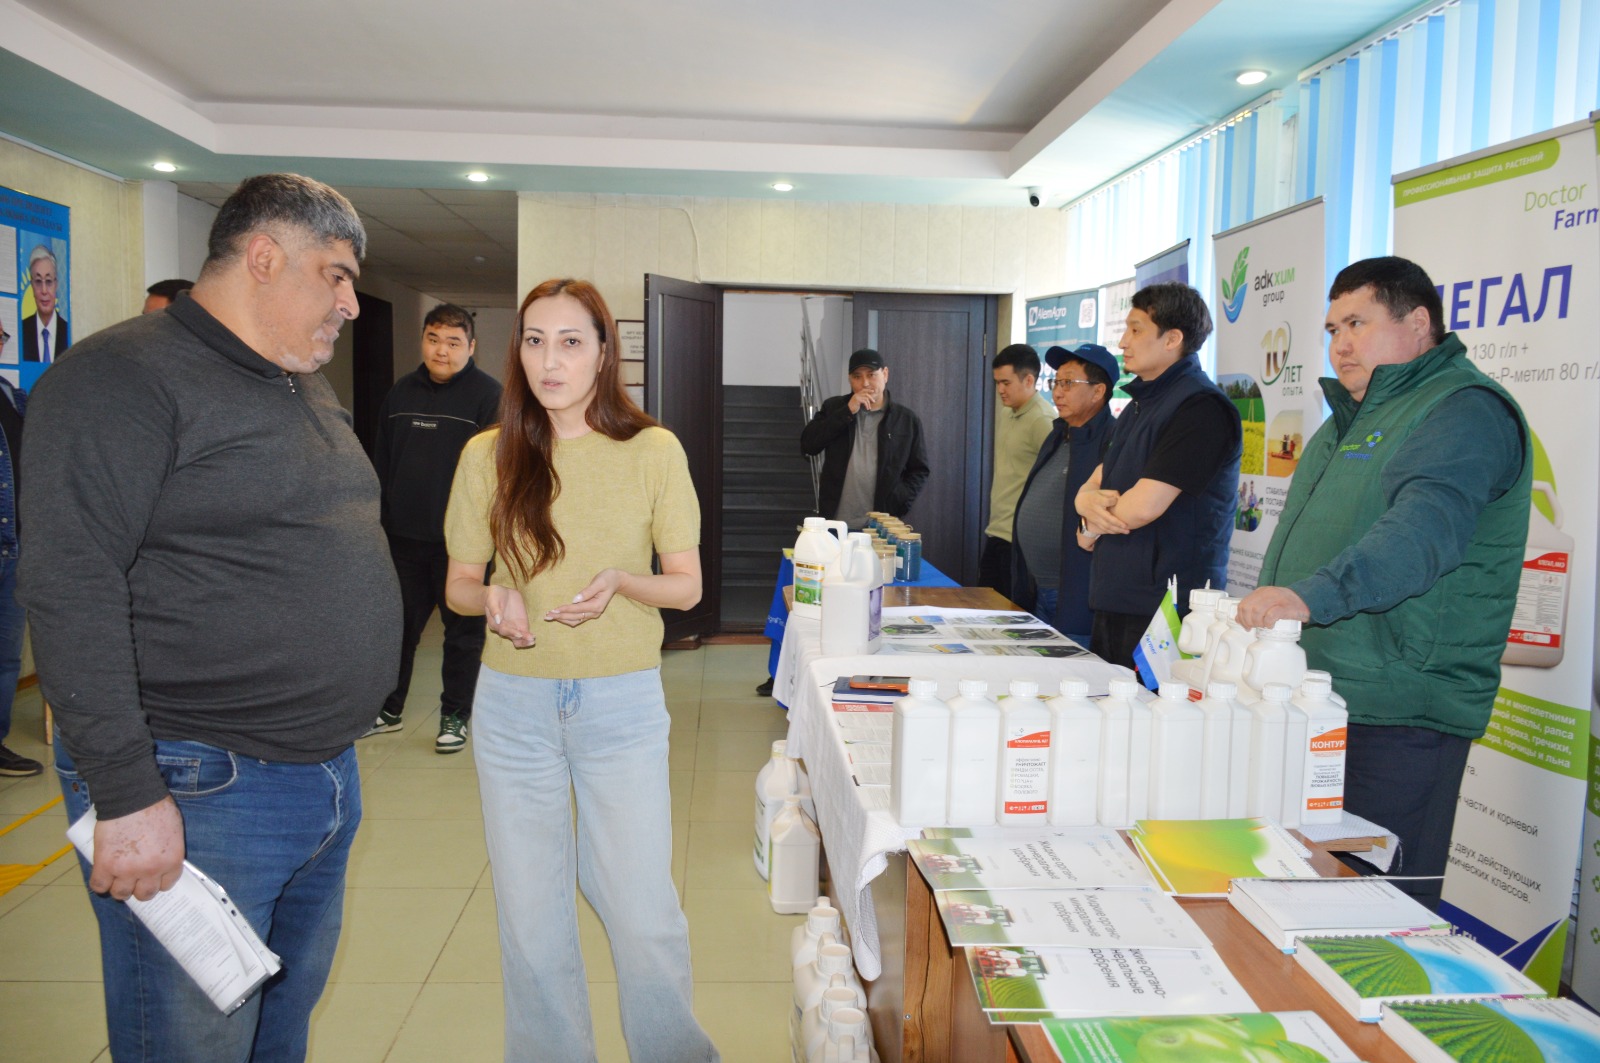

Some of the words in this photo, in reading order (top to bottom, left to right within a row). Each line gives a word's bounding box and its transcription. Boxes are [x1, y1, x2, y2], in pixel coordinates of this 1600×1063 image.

[1402, 171, 1472, 197] ПРОФЕССИОНАЛЬНАЯ
[1473, 164, 1503, 179] ЗАЩИТА
[1504, 151, 1545, 170] РАСТЕНИЙ
[1524, 183, 1587, 212] Doctor
[1263, 290, 1284, 307] group
[1037, 306, 1067, 320] AlemAgro
[1260, 326, 1287, 377] 10
[1471, 343, 1496, 361] 130
[1500, 341, 1517, 359] г/л
[1521, 343, 1529, 355] +
[1283, 364, 1303, 384] ЛЕТ
[1560, 362, 1580, 380] 80
[1282, 386, 1304, 396] ОПЫТА
[1511, 714, 1542, 731] свеклы,
[1544, 725, 1574, 740] рапса
[1512, 701, 1576, 726] многолетними
[1311, 739, 1345, 749] КОНТУР
[1503, 726, 1530, 742] гороха,
[1532, 736, 1572, 755] гречихи,
[1503, 739, 1537, 758] горчицы
[1546, 754, 1571, 769] льна
[1464, 797, 1487, 814] части
[1489, 808, 1495, 818] и
[1497, 811, 1539, 837] корневой
[1455, 843, 1476, 859] двух
[1477, 853, 1541, 892] действующих
[1490, 876, 1532, 904] классов.
[1048, 901, 1079, 933] удобрения
[1068, 897, 1101, 937] минеральные
[1138, 965, 1166, 999] органо-
